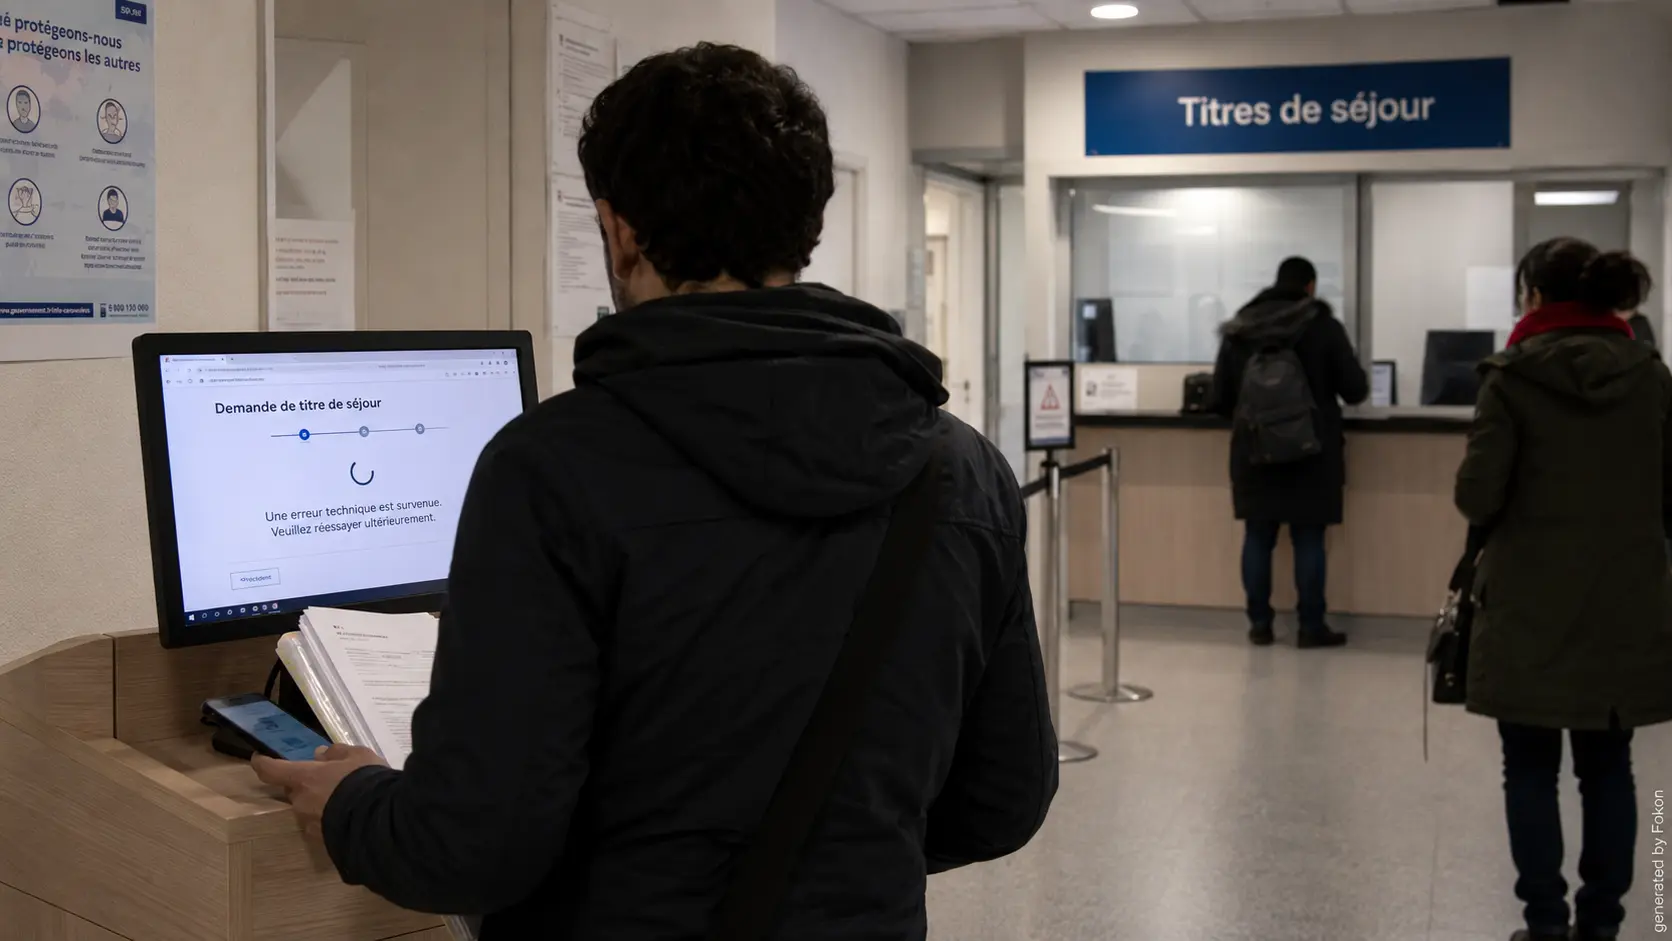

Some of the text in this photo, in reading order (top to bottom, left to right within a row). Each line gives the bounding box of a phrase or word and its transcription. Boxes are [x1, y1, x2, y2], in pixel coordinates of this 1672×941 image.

[0, 12, 11, 27] é
[15, 18, 122, 50] protégeons-nous
[7, 39, 81, 62] protégeons
[84, 49, 101, 65] les
[104, 56, 141, 73] autres
[1178, 91, 1435, 129] Titres de séjour
[215, 397, 382, 414] Demande de titre de séjour
[265, 499, 443, 522] Une erreur technique est survenue.
[271, 513, 437, 537] Veuillez réessayer ultérieurement.
